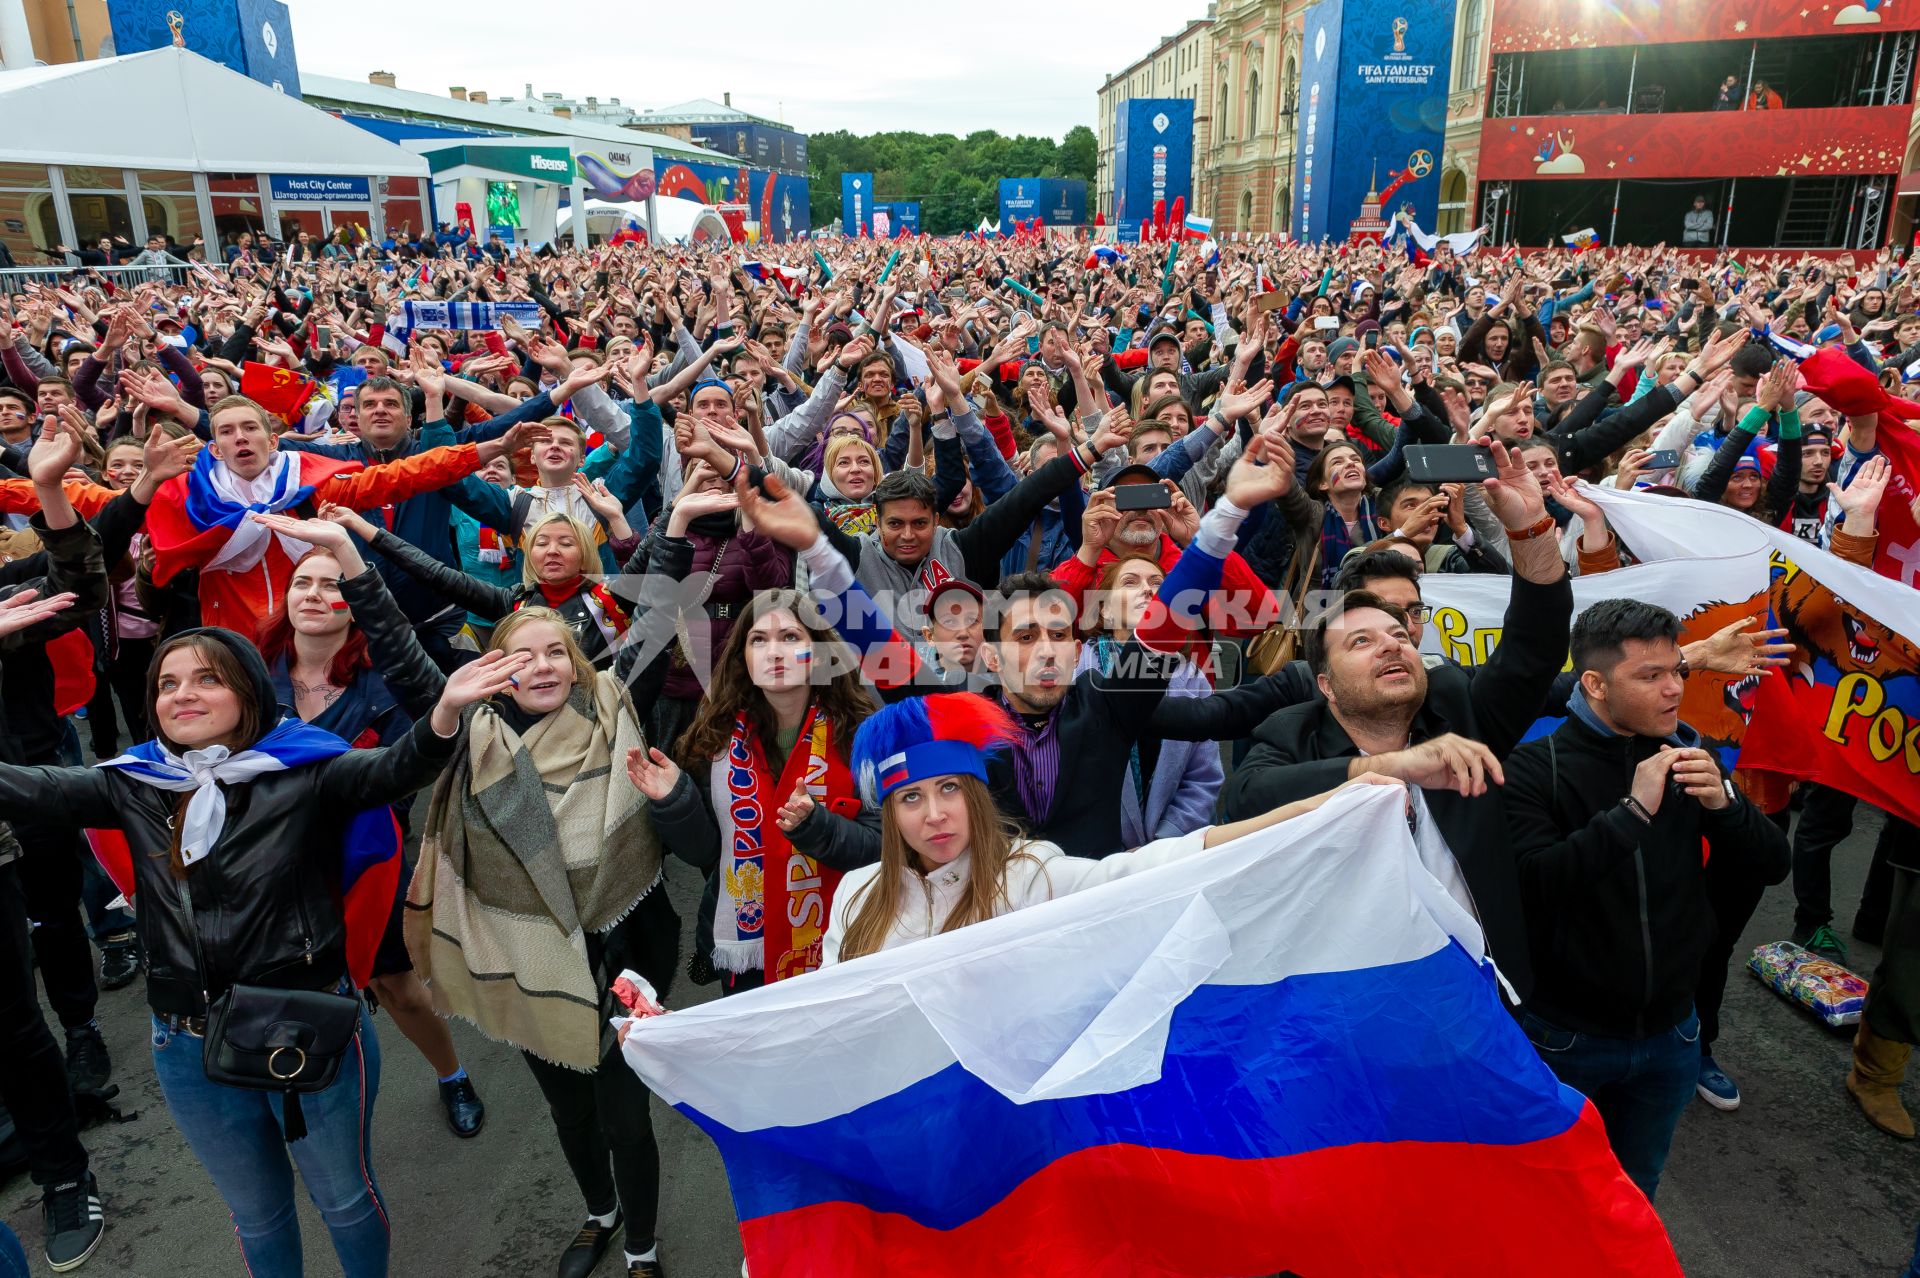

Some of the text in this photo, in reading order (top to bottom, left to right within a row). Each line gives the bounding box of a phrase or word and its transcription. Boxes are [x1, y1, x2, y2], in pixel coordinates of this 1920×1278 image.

[1358, 65, 1435, 76] FIFA FAN FEST
[1365, 76, 1428, 84] SAINT PETERSBURG
[530, 154, 568, 172] Hisense
[288, 180, 352, 191] Host City Center
[274, 191, 299, 199] Шатер
